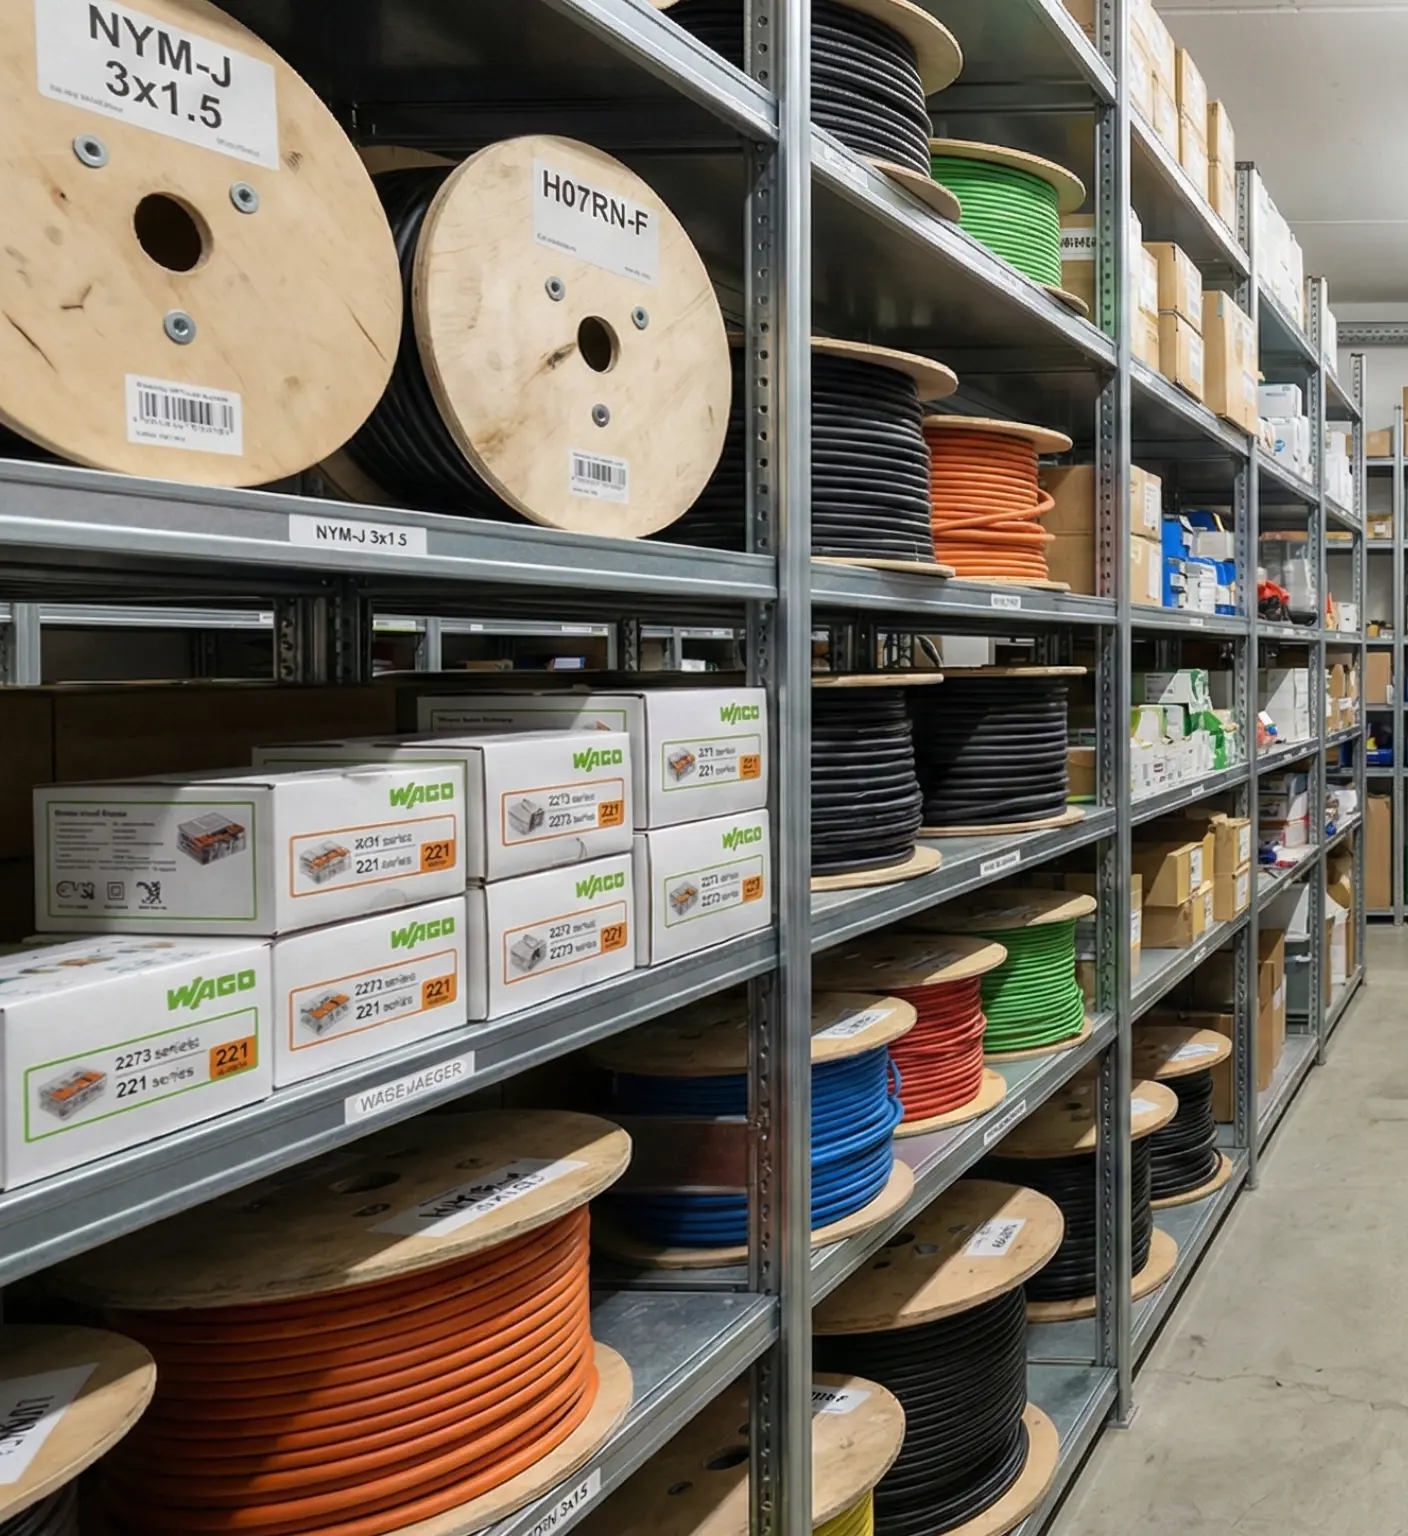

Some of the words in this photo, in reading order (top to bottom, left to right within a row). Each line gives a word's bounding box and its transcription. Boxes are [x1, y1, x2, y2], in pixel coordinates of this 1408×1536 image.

[89, 4, 231, 88] NYM-J
[106, 60, 222, 129] 3x1.5
[543, 170, 649, 235] H07RN-F
[316, 524, 366, 543] NYM-J
[720, 703, 760, 725] WAGO
[573, 747, 623, 773] WAGO
[389, 781, 454, 809] WAGO
[722, 822, 762, 851] WAGO
[424, 843, 450, 862] 221
[356, 857, 379, 875] 221
[576, 871, 625, 900] WAGO
[391, 916, 456, 950] WAGO
[166, 968, 256, 1011] WAGO
[426, 978, 451, 999] 221
[356, 1000, 380, 1021] 221
[115, 1048, 152, 1072] 2273
[216, 1041, 248, 1067] 221
[116, 1075, 147, 1099] 221
